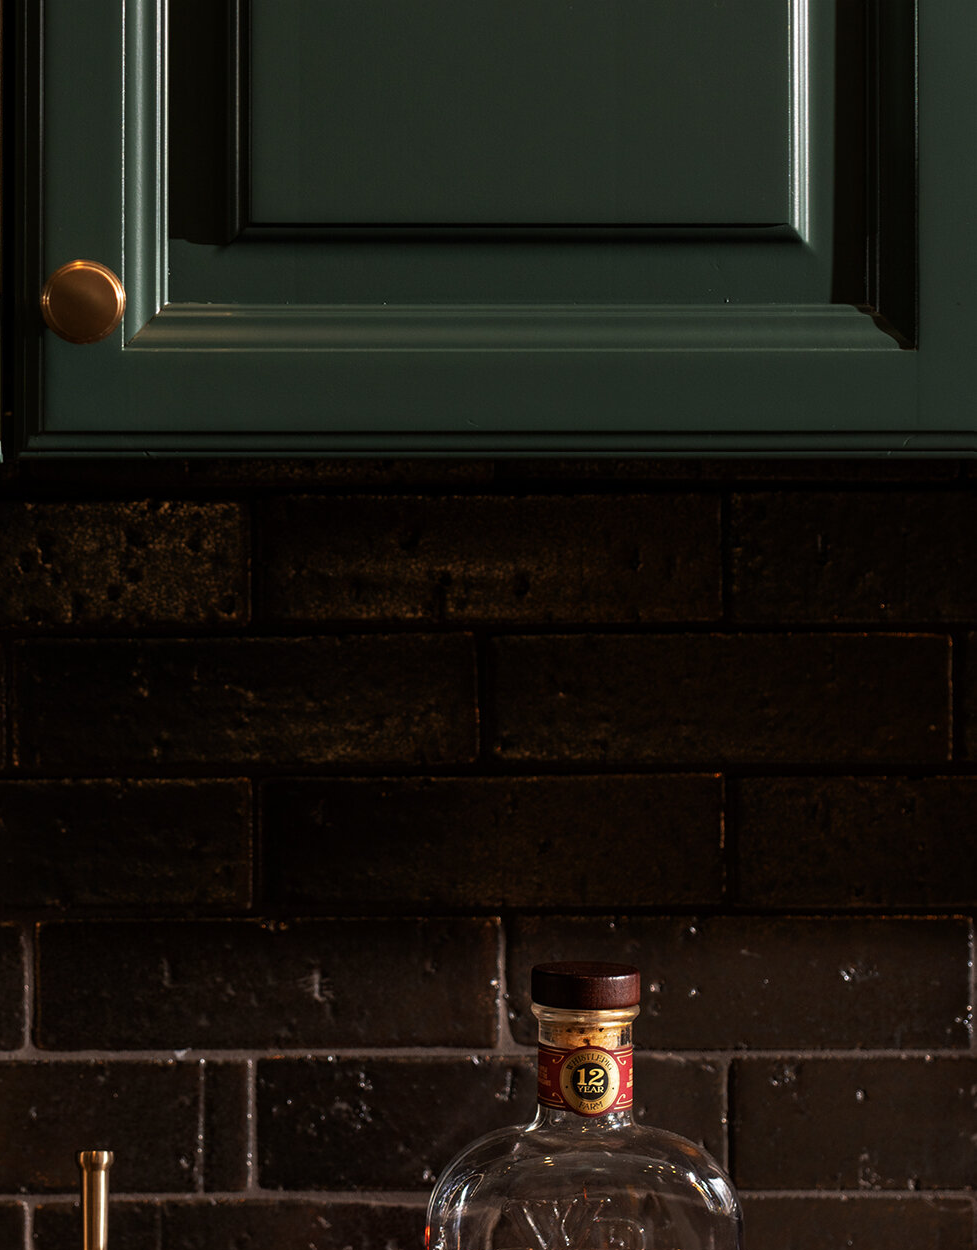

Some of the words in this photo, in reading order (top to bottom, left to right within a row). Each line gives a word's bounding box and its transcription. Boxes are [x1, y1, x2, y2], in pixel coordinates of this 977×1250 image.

[577, 1068, 605, 1086] 12
[577, 1085, 604, 1093] YEAR
[579, 1101, 604, 1111] FARM
